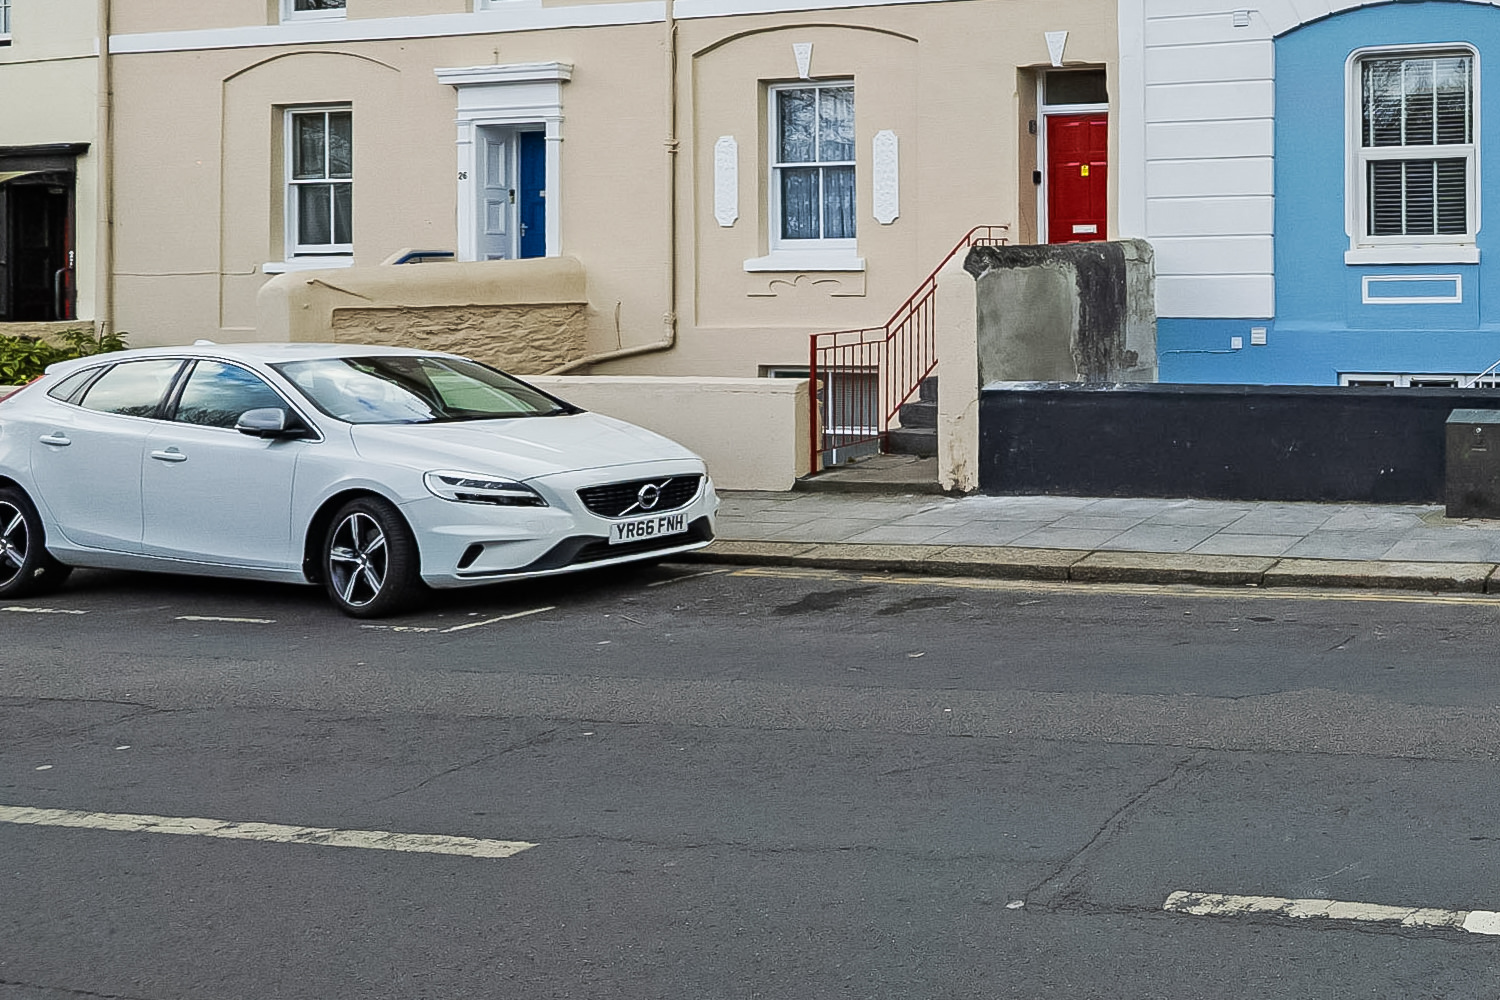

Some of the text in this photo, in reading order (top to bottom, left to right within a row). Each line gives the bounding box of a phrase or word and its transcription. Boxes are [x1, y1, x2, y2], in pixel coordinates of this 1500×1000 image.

[458, 171, 468, 180] 26
[616, 514, 684, 539] YR66 FNH
